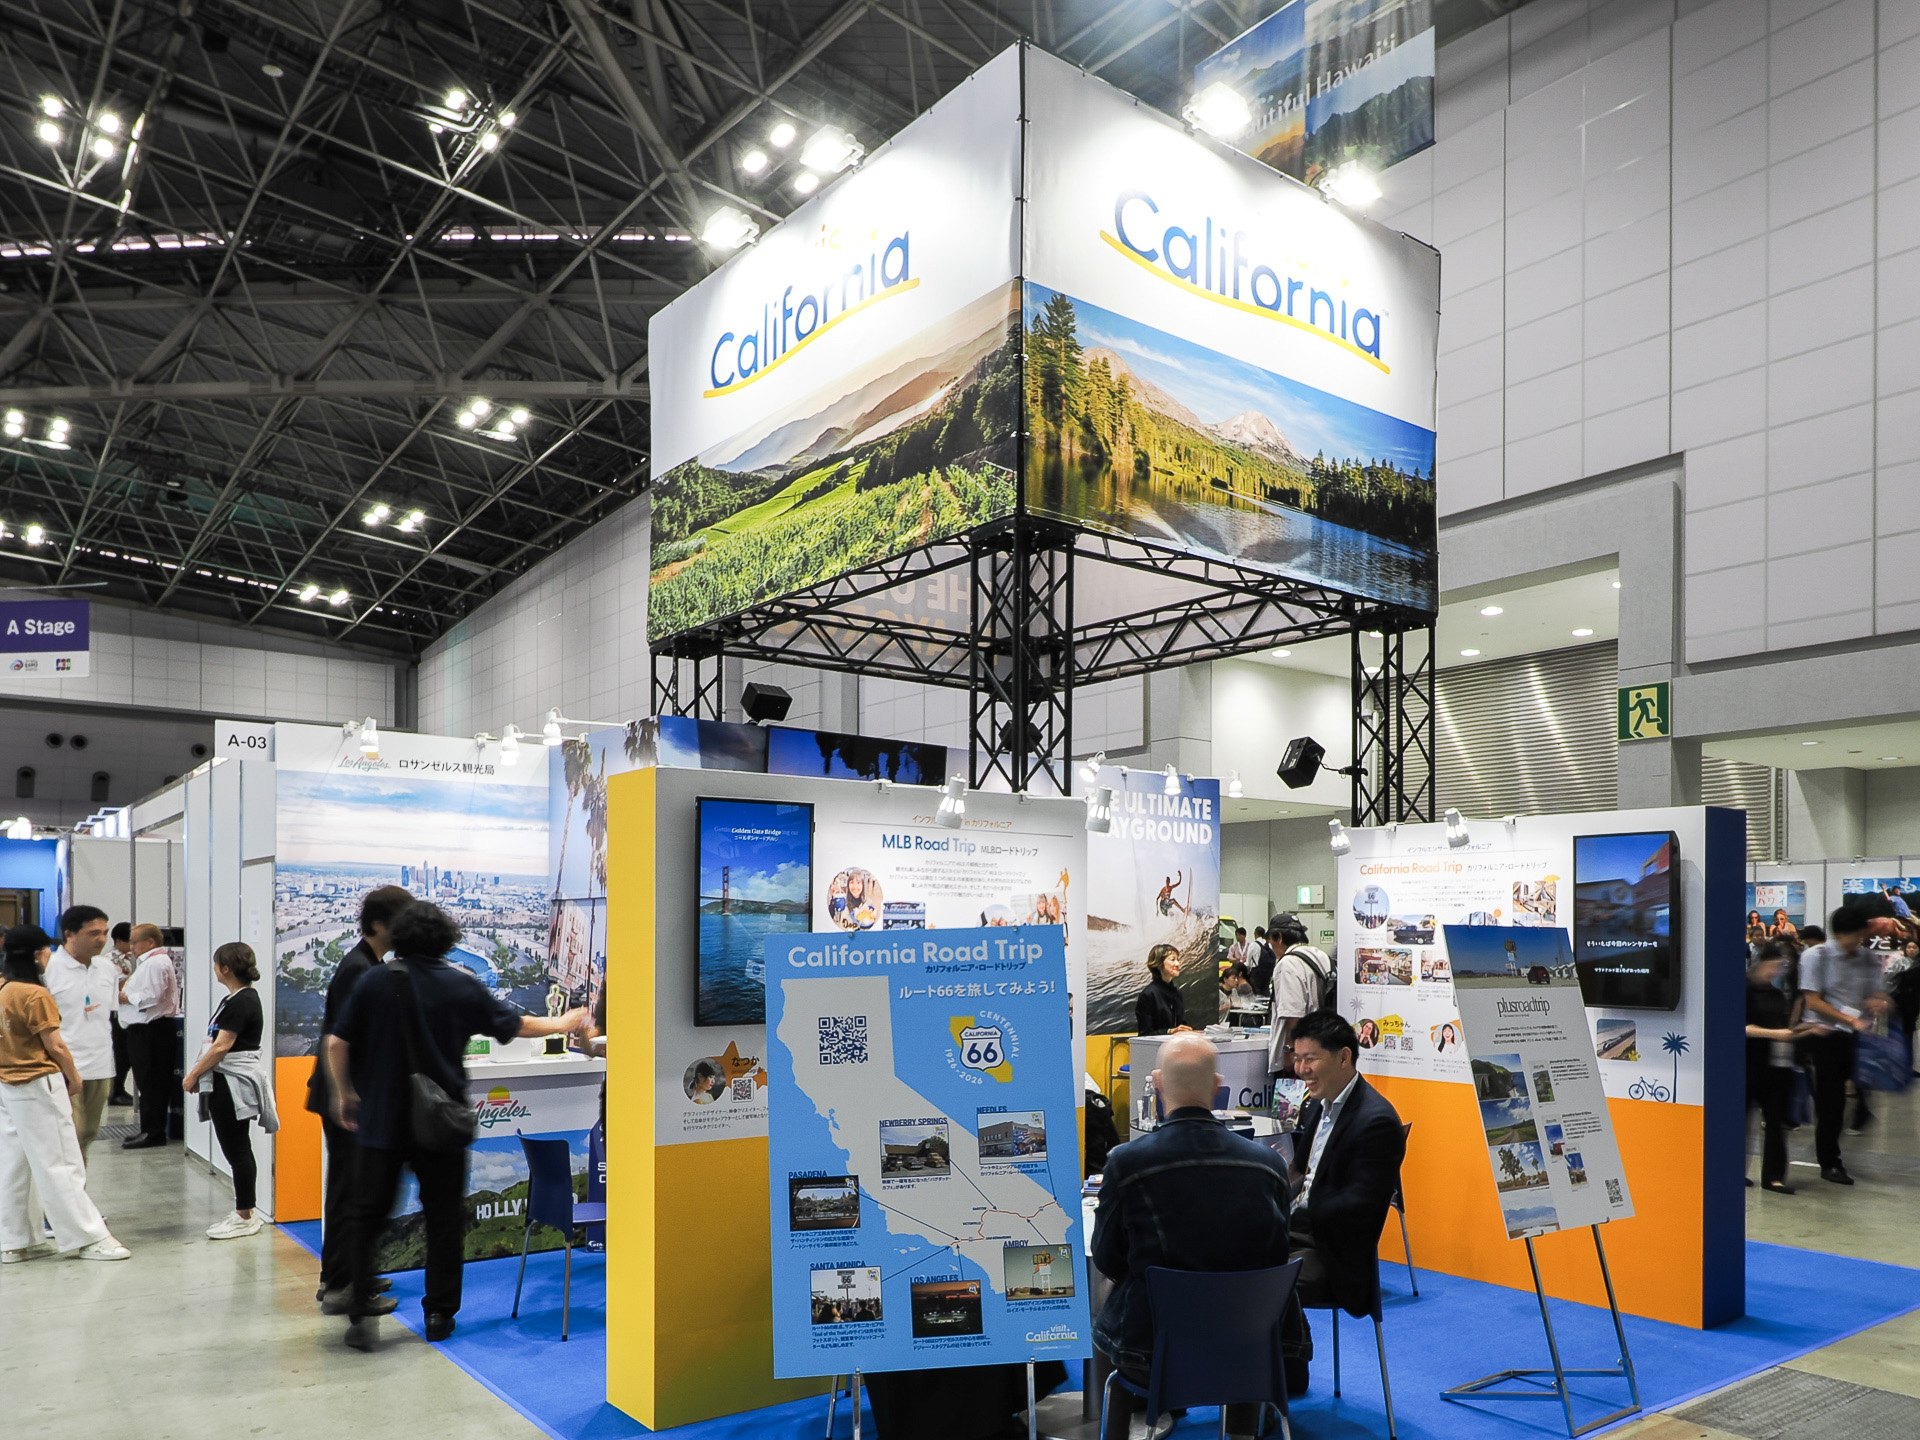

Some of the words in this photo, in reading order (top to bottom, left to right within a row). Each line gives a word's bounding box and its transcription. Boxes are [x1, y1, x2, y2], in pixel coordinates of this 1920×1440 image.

[1243, 83, 1310, 141] autiful
[1114, 189, 1380, 360] California
[711, 229, 909, 389] California
[7, 619, 20, 635] A
[24, 618, 76, 637] Stage
[227, 733, 267, 750] A-03
[399, 759, 495, 776] ロサンゼルス観光局
[1084, 787, 1120, 813] TE
[1124, 792, 1212, 820] ULTIMATE
[912, 814, 937, 824] インフル
[971, 819, 1013, 828] カリフォルニア
[764, 828, 781, 836] Bridge
[1099, 815, 1213, 845] AYGROUND
[882, 833, 912, 850] MLB
[915, 835, 949, 851] Road
[952, 837, 977, 857] Trip
[980, 845, 1039, 857] MLBロードトリップ
[1359, 863, 1410, 876] California
[1412, 862, 1441, 873] Road
[1443, 860, 1463, 874] Trip
[1467, 862, 1548, 872] カリフォルニア・ロードトリップ
[788, 943, 916, 969] California
[922, 940, 989, 963] Road
[995, 938, 1043, 965] Trip
[925, 962, 1027, 974] カリフォルニア・ロードトリップ
[1496, 996, 1551, 1018] plusroadtrip
[979, 1010, 1020, 1058] CENTENNIAL
[731, 1055, 760, 1067] なつか
[966, 1042, 998, 1064] 66
[976, 1105, 1008, 1114] NEEDLES
[879, 1119, 917, 1128] NEWBERRY
[917, 1117, 948, 1126] SPRINGS
[788, 1170, 828, 1179] PASADENA
[1003, 1240, 1029, 1248] AMBOY
[810, 1261, 835, 1270] SANTA
[836, 1260, 867, 1269] MONICA
[910, 1276, 924, 1284] LOS
[924, 1274, 959, 1283] ANGELES
[1025, 1330, 1078, 1341] California
[1050, 1324, 1067, 1332] visit
